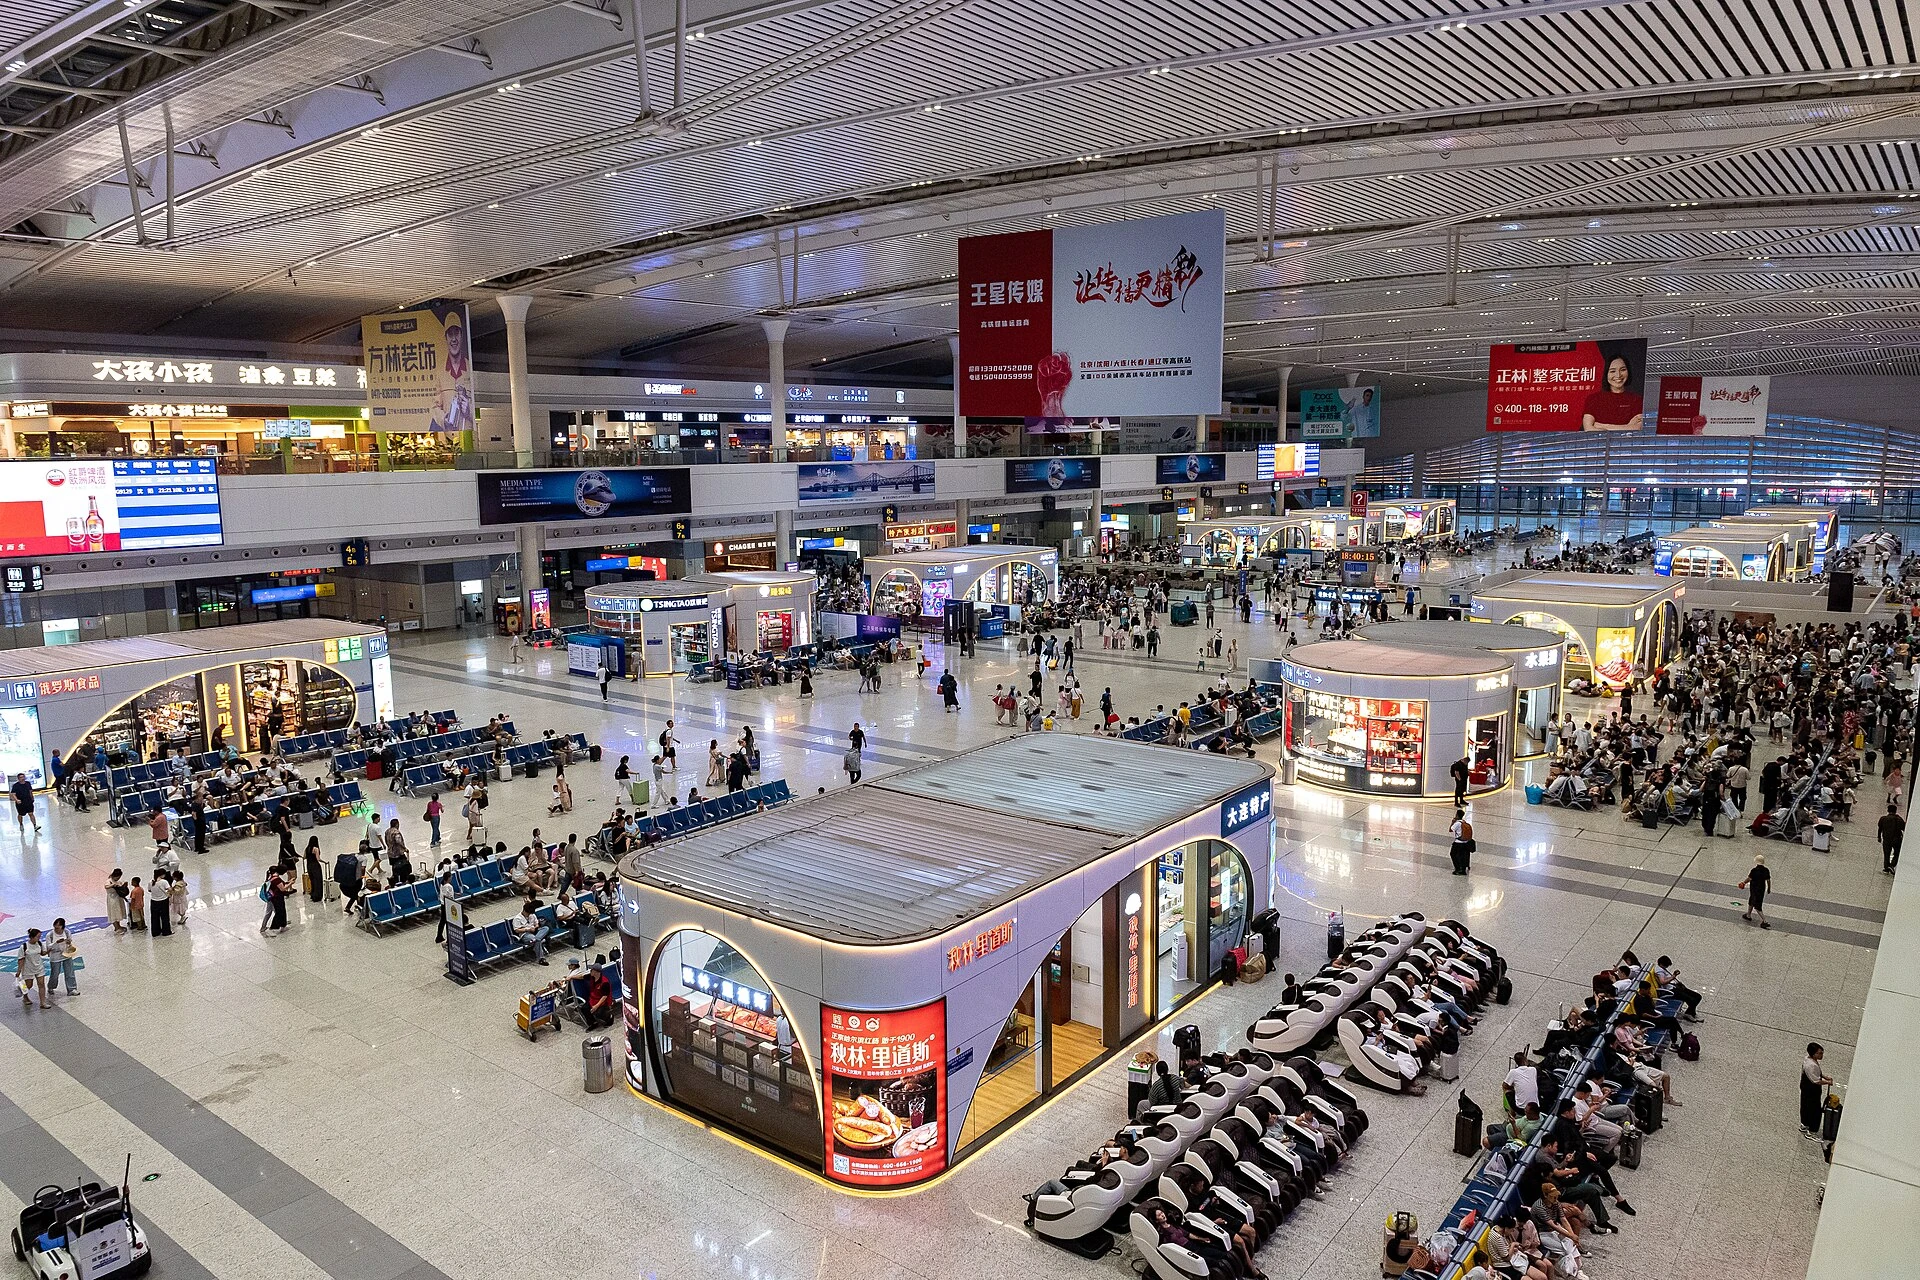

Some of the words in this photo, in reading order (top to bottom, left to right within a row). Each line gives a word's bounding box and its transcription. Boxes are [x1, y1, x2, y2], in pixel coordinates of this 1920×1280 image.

[1073, 244, 1203, 313] 让传播更精彩
[971, 279, 1043, 306] 王星传媒
[368, 342, 437, 373] 方林装饰
[92, 359, 214, 383] 大孩小孩
[292, 367, 337, 387] 豆浆
[1495, 368, 1528, 384] 正林
[1533, 366, 1596, 384] 整家定制
[1504, 404, 1569, 413] 400-118-1918
[500, 480, 523, 488] MEDIA
[524, 478, 543, 486] TYPE
[1341, 552, 1375, 561] 18:40:15
[711, 610, 720, 648] TSINGTAO
[39, 675, 101, 697] 俄罗斯食品
[214, 683, 231, 709] 한국
[1227, 791, 1270, 828] 大连特产
[831, 1032, 879, 1045] 正宗哈尔滨红肠
[881, 1033, 916, 1044] 始于1900
[830, 1038, 930, 1068] 秋林·里道斯
